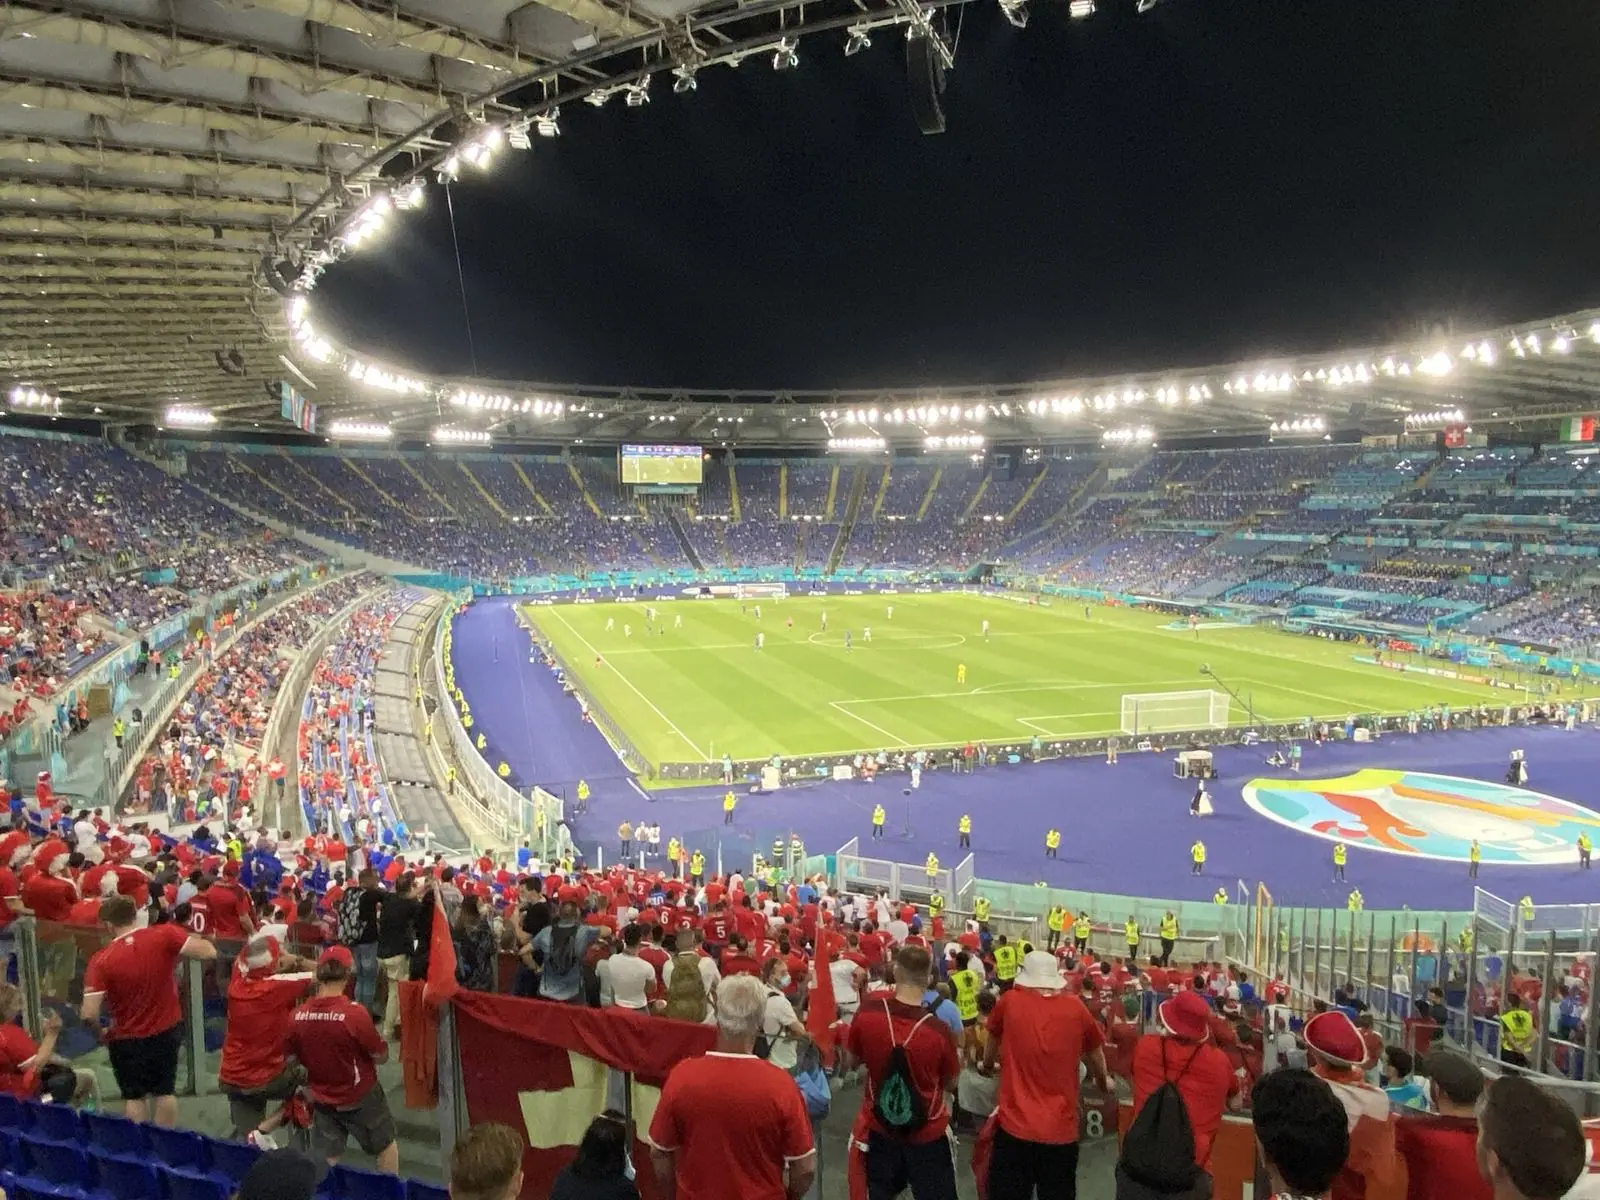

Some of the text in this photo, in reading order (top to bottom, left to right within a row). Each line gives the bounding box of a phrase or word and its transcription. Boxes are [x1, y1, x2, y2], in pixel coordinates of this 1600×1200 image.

[661, 911, 669, 924] 6
[717, 926, 725, 938] 5
[763, 943, 773, 956] 7
[1087, 1110, 1104, 1137] 8
